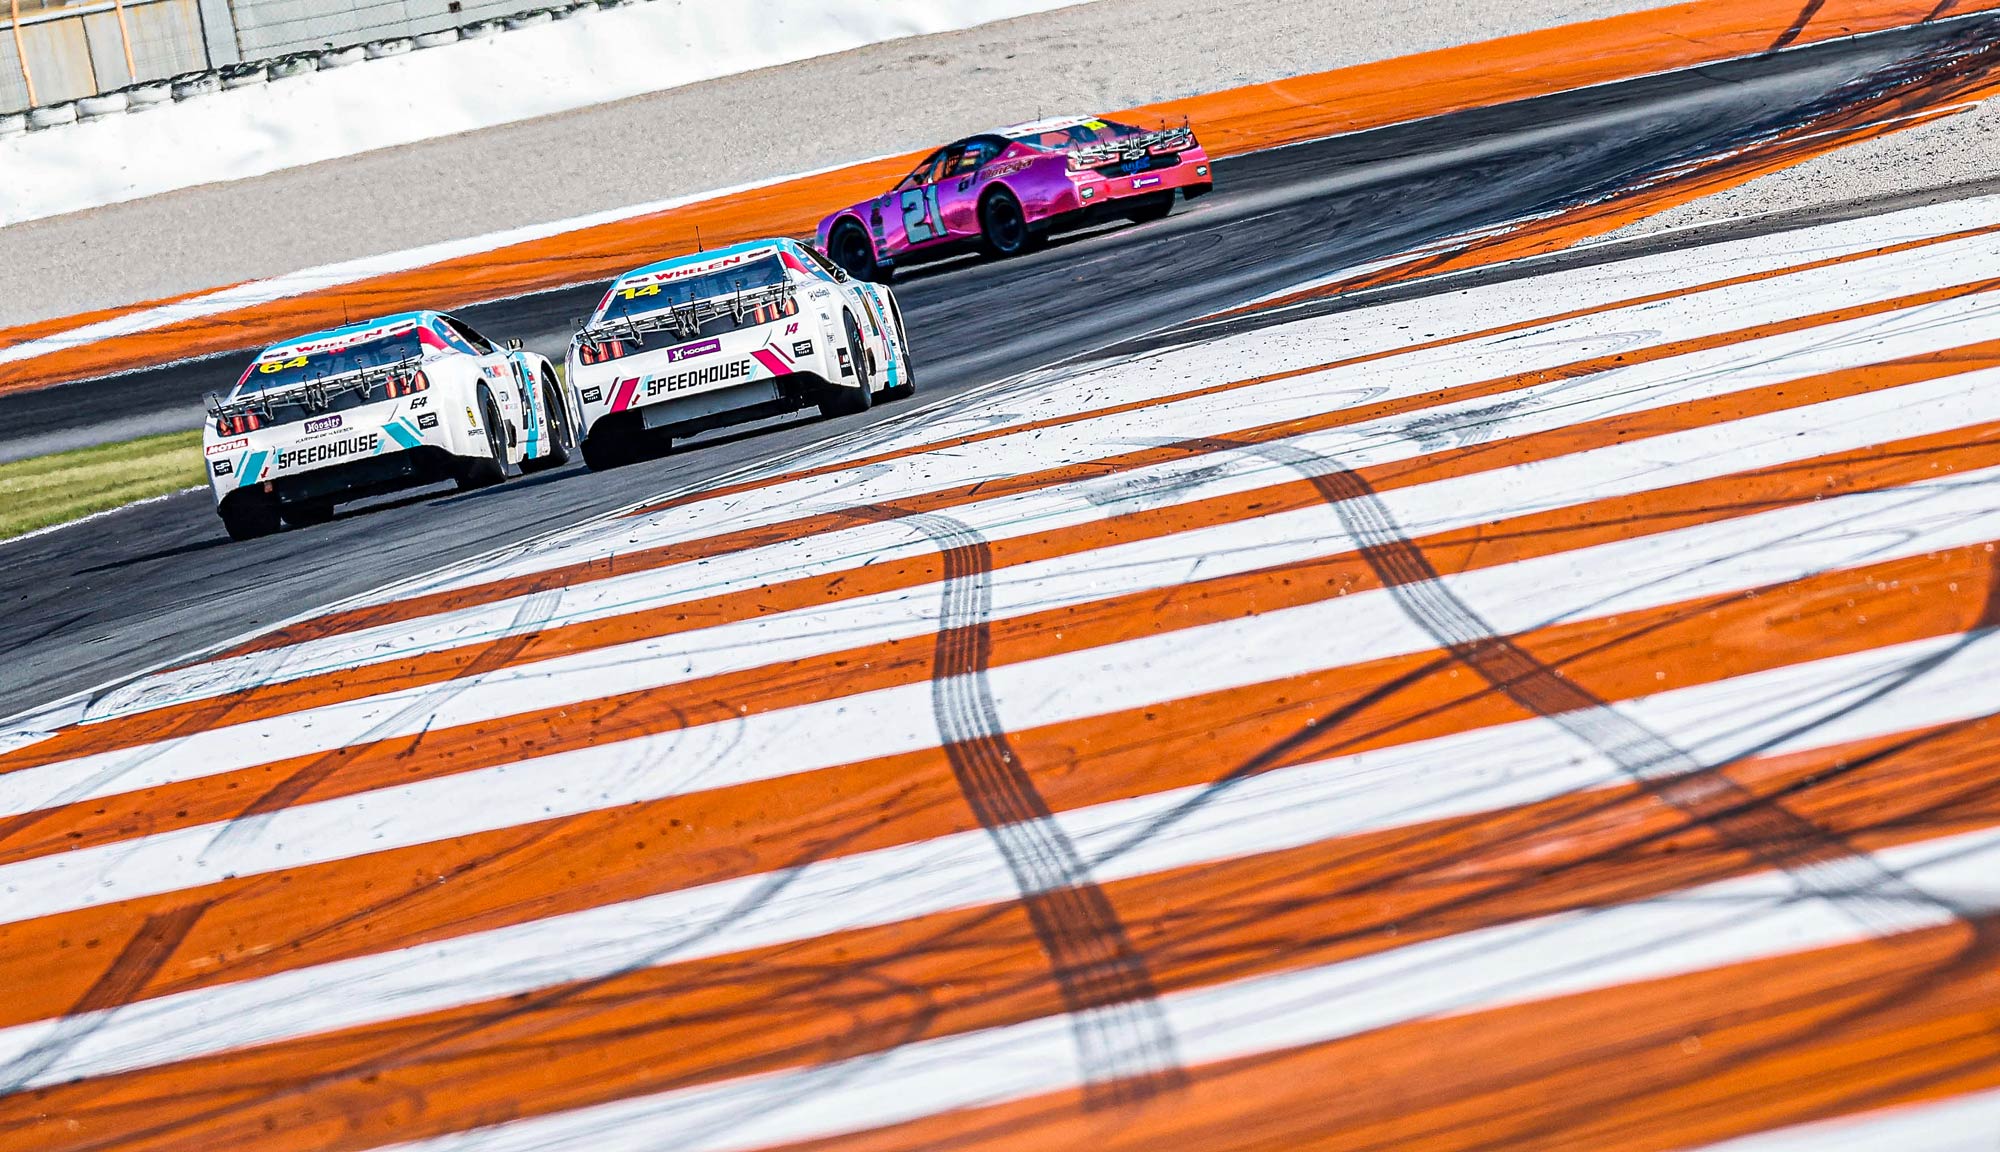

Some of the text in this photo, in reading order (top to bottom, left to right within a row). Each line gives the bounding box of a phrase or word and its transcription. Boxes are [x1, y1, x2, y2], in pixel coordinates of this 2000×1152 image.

[901, 184, 949, 245] 21
[654, 256, 741, 280] WHELEN
[617, 284, 661, 300] 14
[784, 322, 799, 337] 14
[295, 329, 383, 353] WHELEN
[683, 343, 717, 356] HOOSIER
[259, 356, 309, 374] 64
[647, 359, 751, 397] SPEEDHOUSE
[410, 396, 428, 410] 64
[206, 439, 248, 455] MOTUL
[278, 433, 378, 470] SPEEDHOUSE
